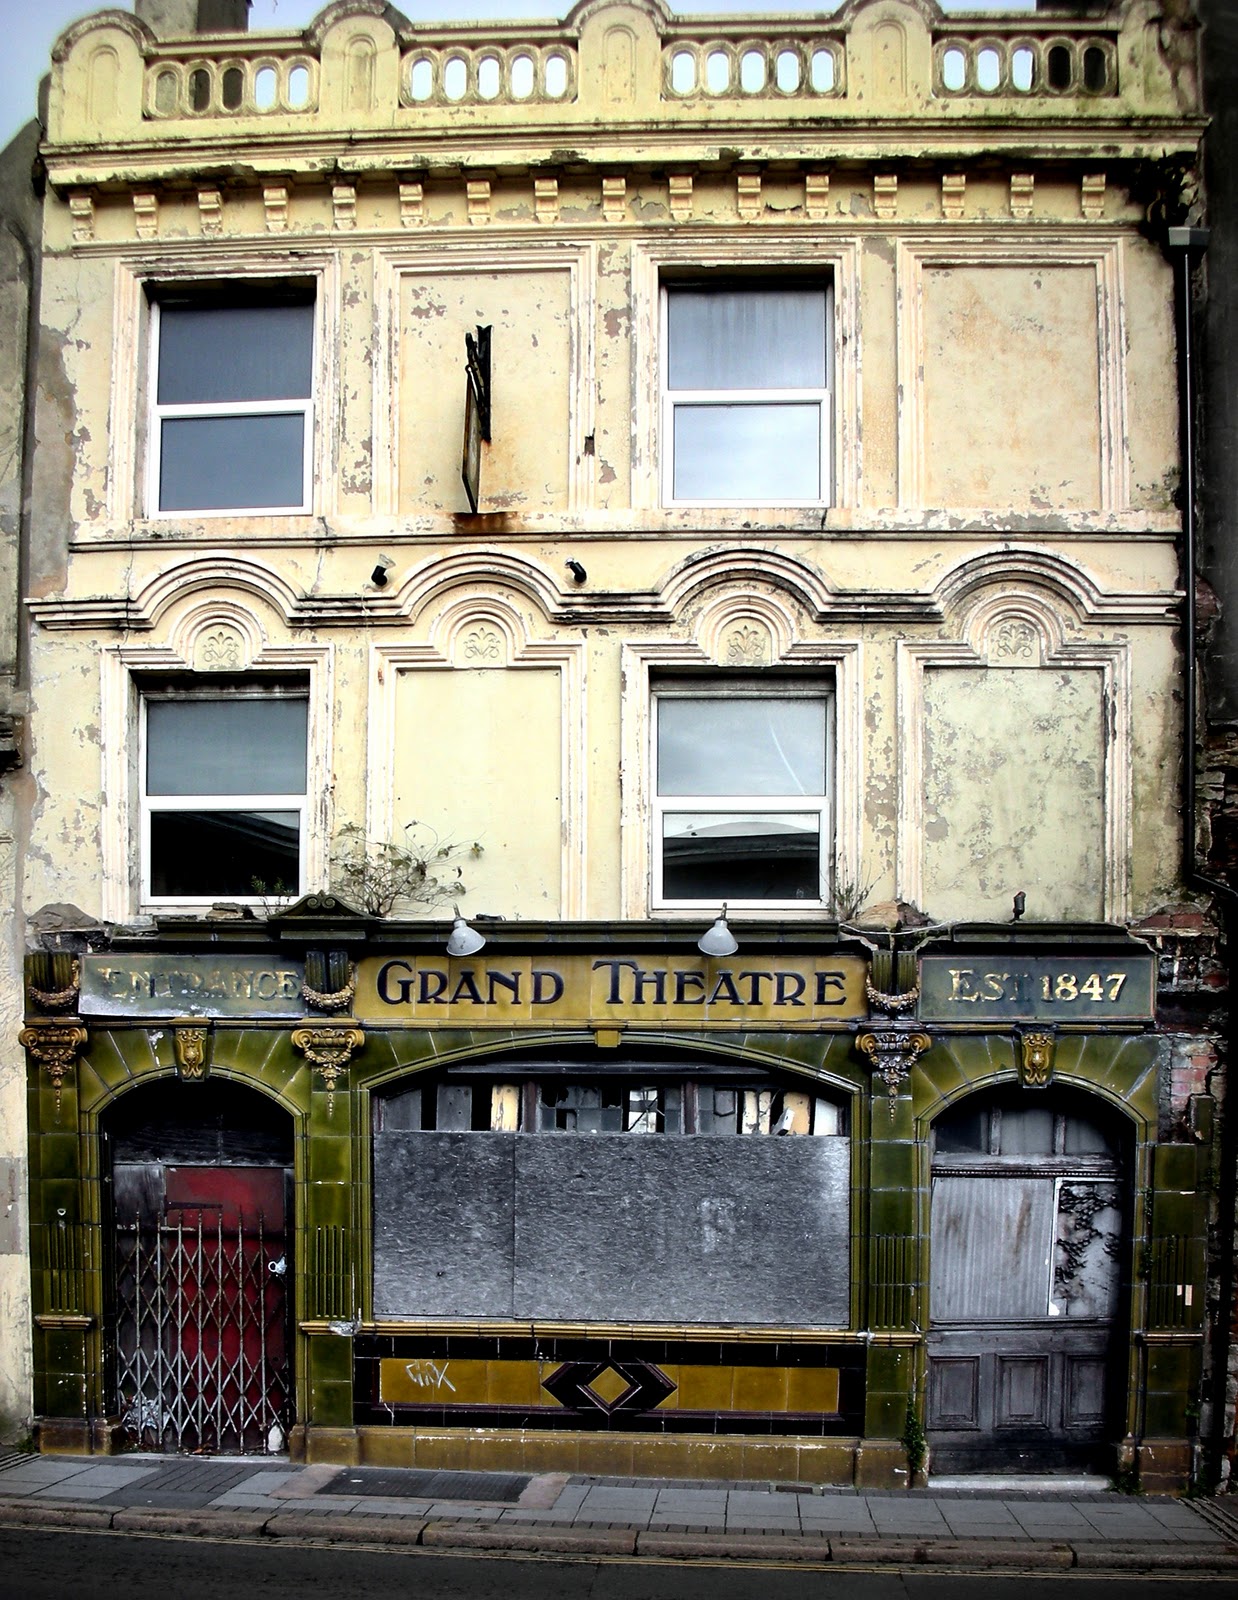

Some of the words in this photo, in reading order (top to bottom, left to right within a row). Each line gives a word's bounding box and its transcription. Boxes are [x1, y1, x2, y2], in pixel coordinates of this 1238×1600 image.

[98, 967, 300, 1000] ENTRANCE
[376, 959, 565, 1005] GRAND
[592, 959, 848, 1006] THEATRE
[948, 969, 1032, 1001] EST
[1039, 973, 1127, 1001] 1847
